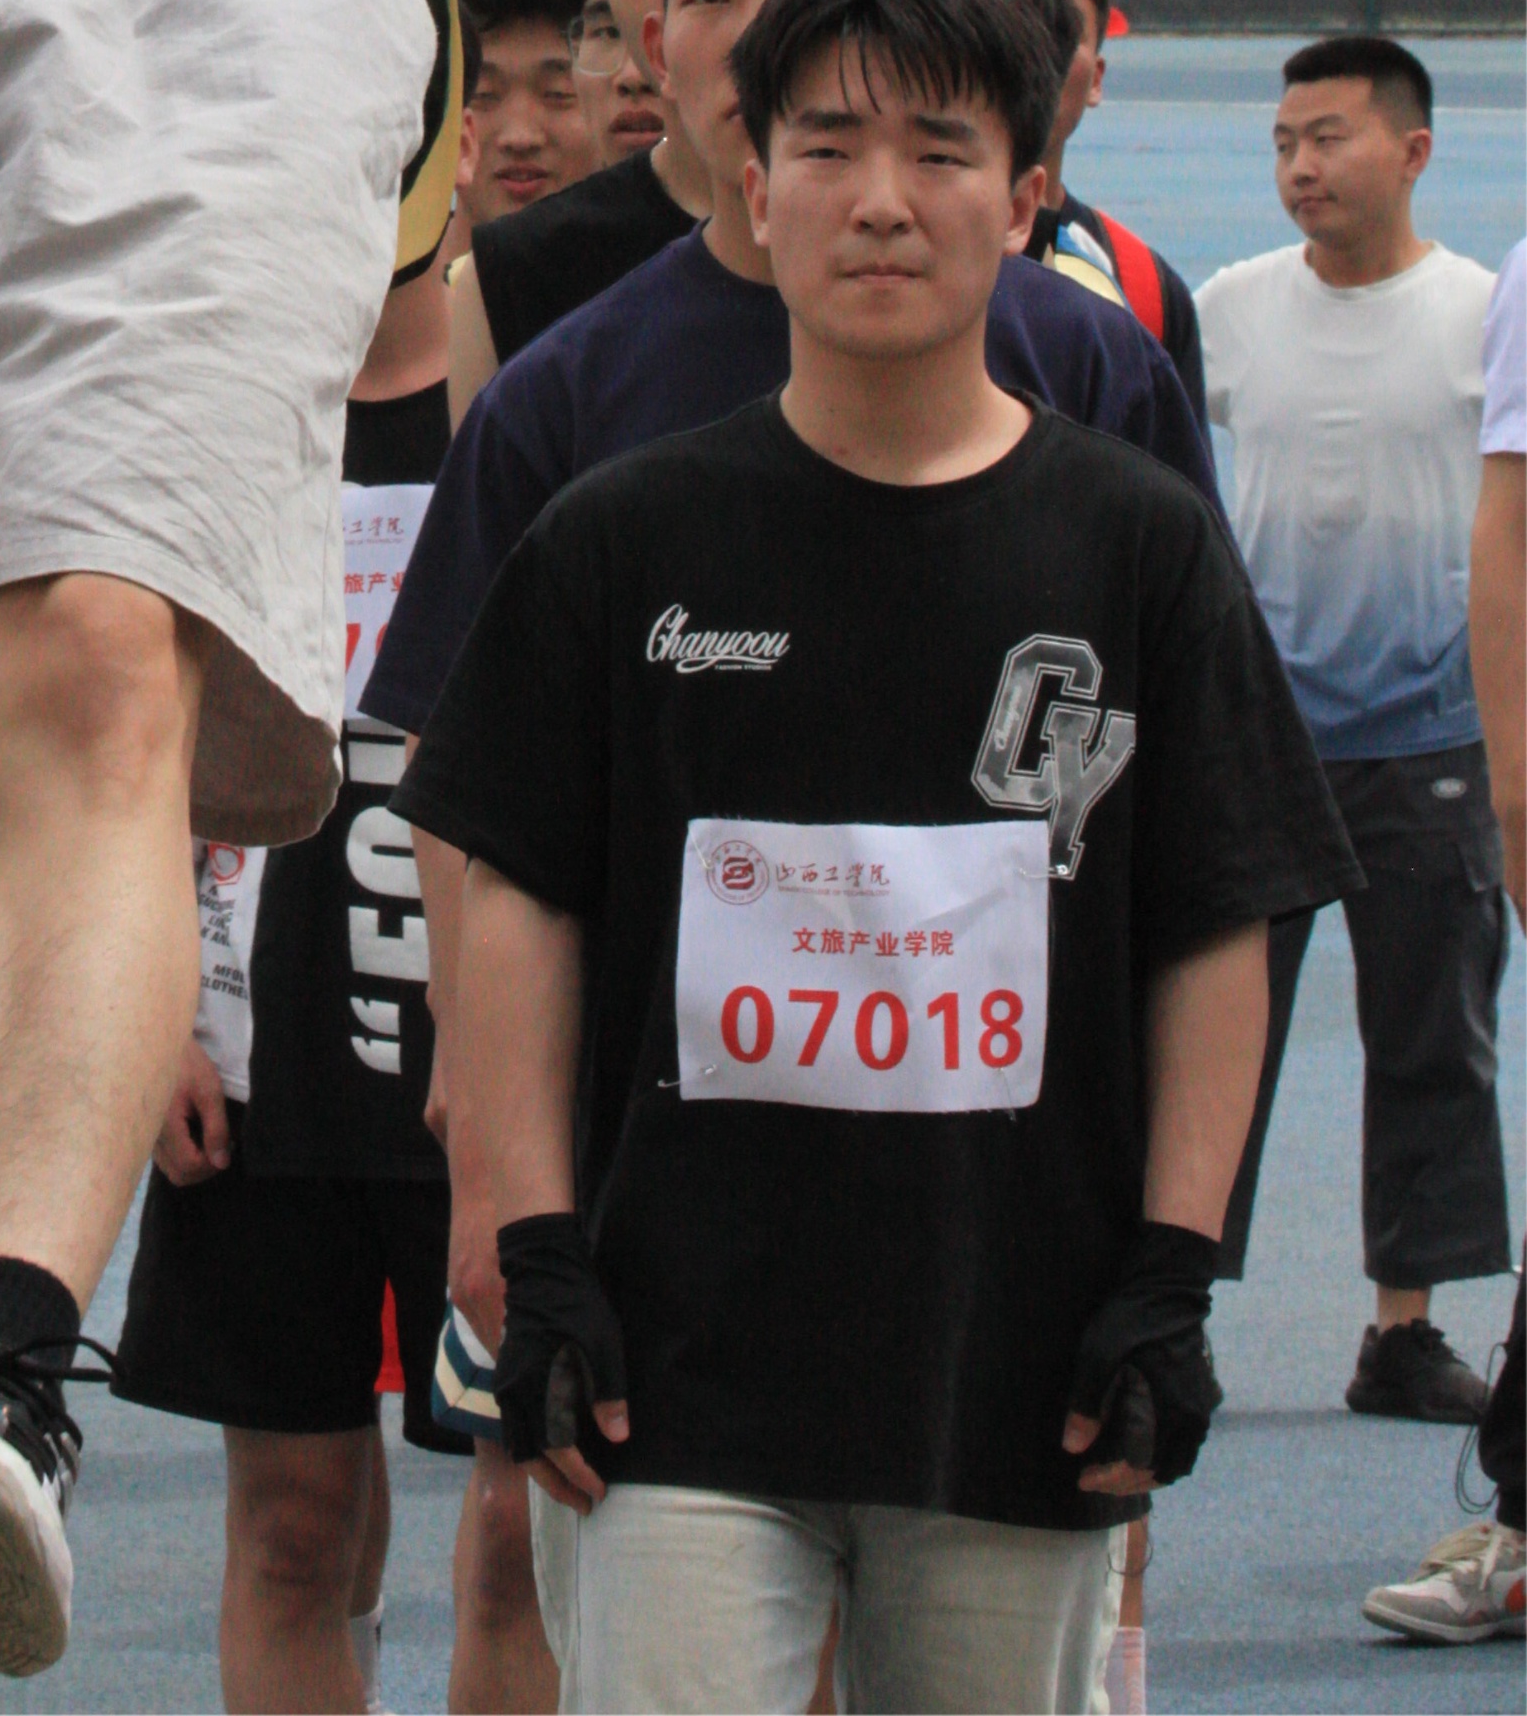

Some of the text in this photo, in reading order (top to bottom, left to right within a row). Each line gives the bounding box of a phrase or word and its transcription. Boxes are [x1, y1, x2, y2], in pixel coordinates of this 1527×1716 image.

[342, 516, 405, 537] 工学院
[775, 862, 890, 887] 山西工学院
[792, 926, 955, 957] 文旅产业学院
[720, 984, 1024, 1071] 07018
